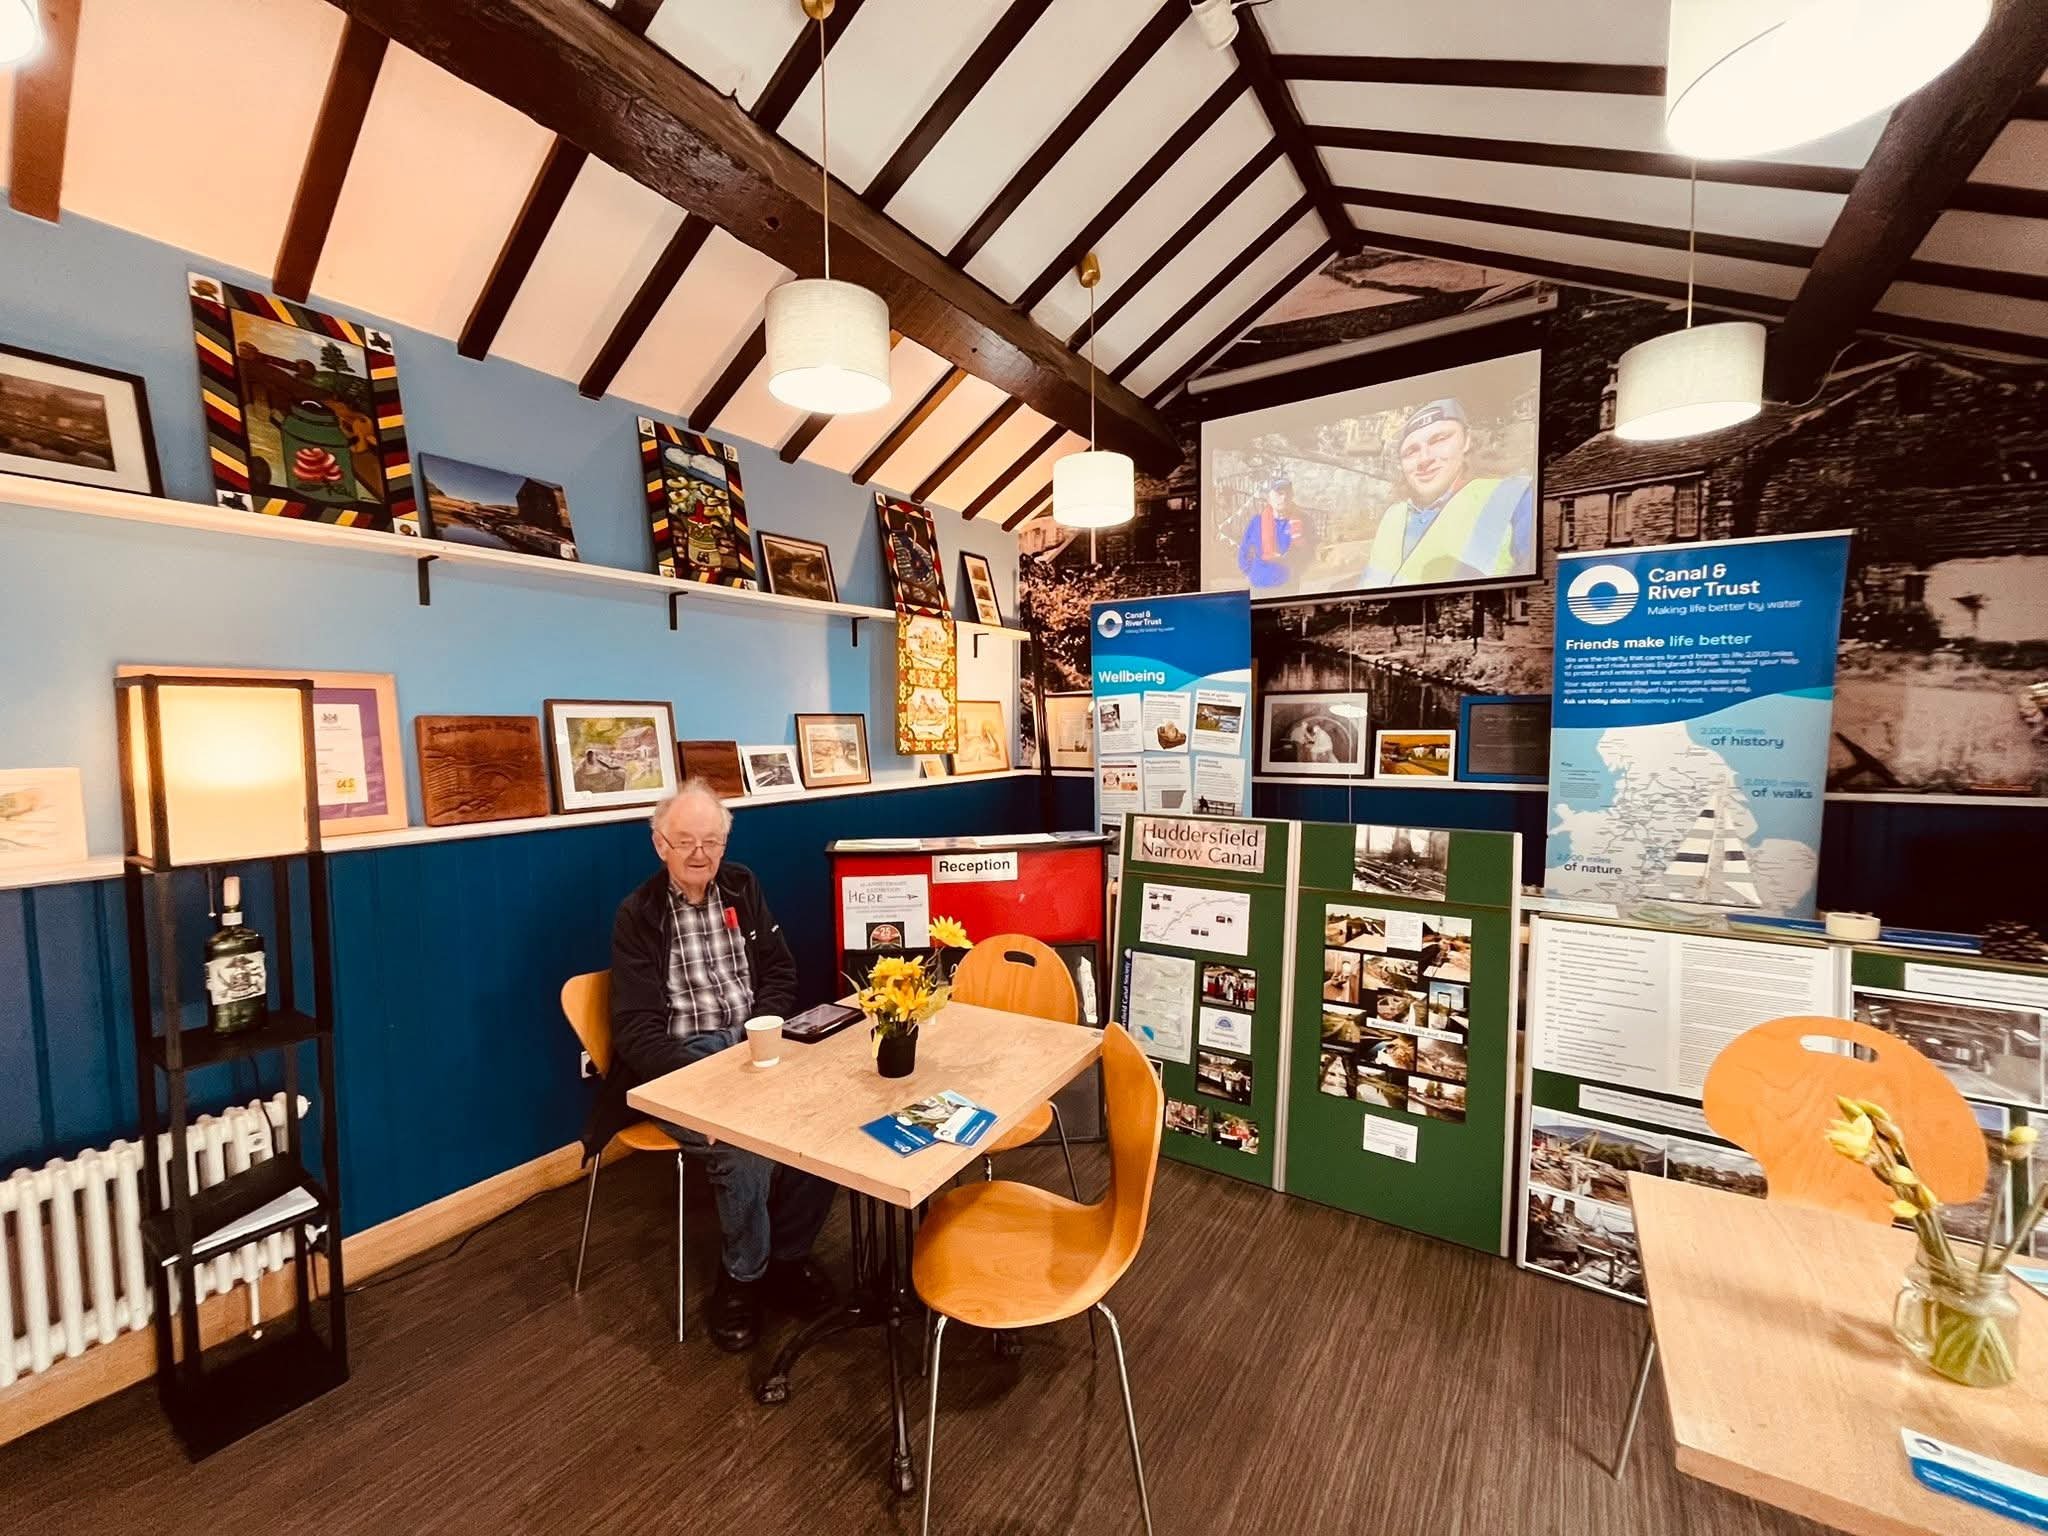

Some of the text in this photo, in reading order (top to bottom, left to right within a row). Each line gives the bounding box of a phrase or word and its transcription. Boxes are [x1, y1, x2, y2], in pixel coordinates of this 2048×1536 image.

[1648, 563, 1727, 583] Canal &
[1648, 581, 1761, 600] River Trust
[1124, 611, 1145, 619] Canal
[1647, 599, 1803, 616] Making life better by water
[1125, 619, 1143, 627] River
[1565, 634, 1752, 651] Friends make life better
[1098, 669, 1166, 685] Wellbeing
[1587, 698, 1609, 706] today
[1711, 735, 1785, 750] of history
[1751, 787, 1814, 799] of walks
[1142, 823, 1259, 848] Huddersfield
[1141, 842, 1258, 867] Narrow Canal
[938, 858, 1011, 874] Reception
[1564, 862, 1623, 875] of nature
[848, 889, 884, 904] HERE
[880, 927, 892, 937] 25
